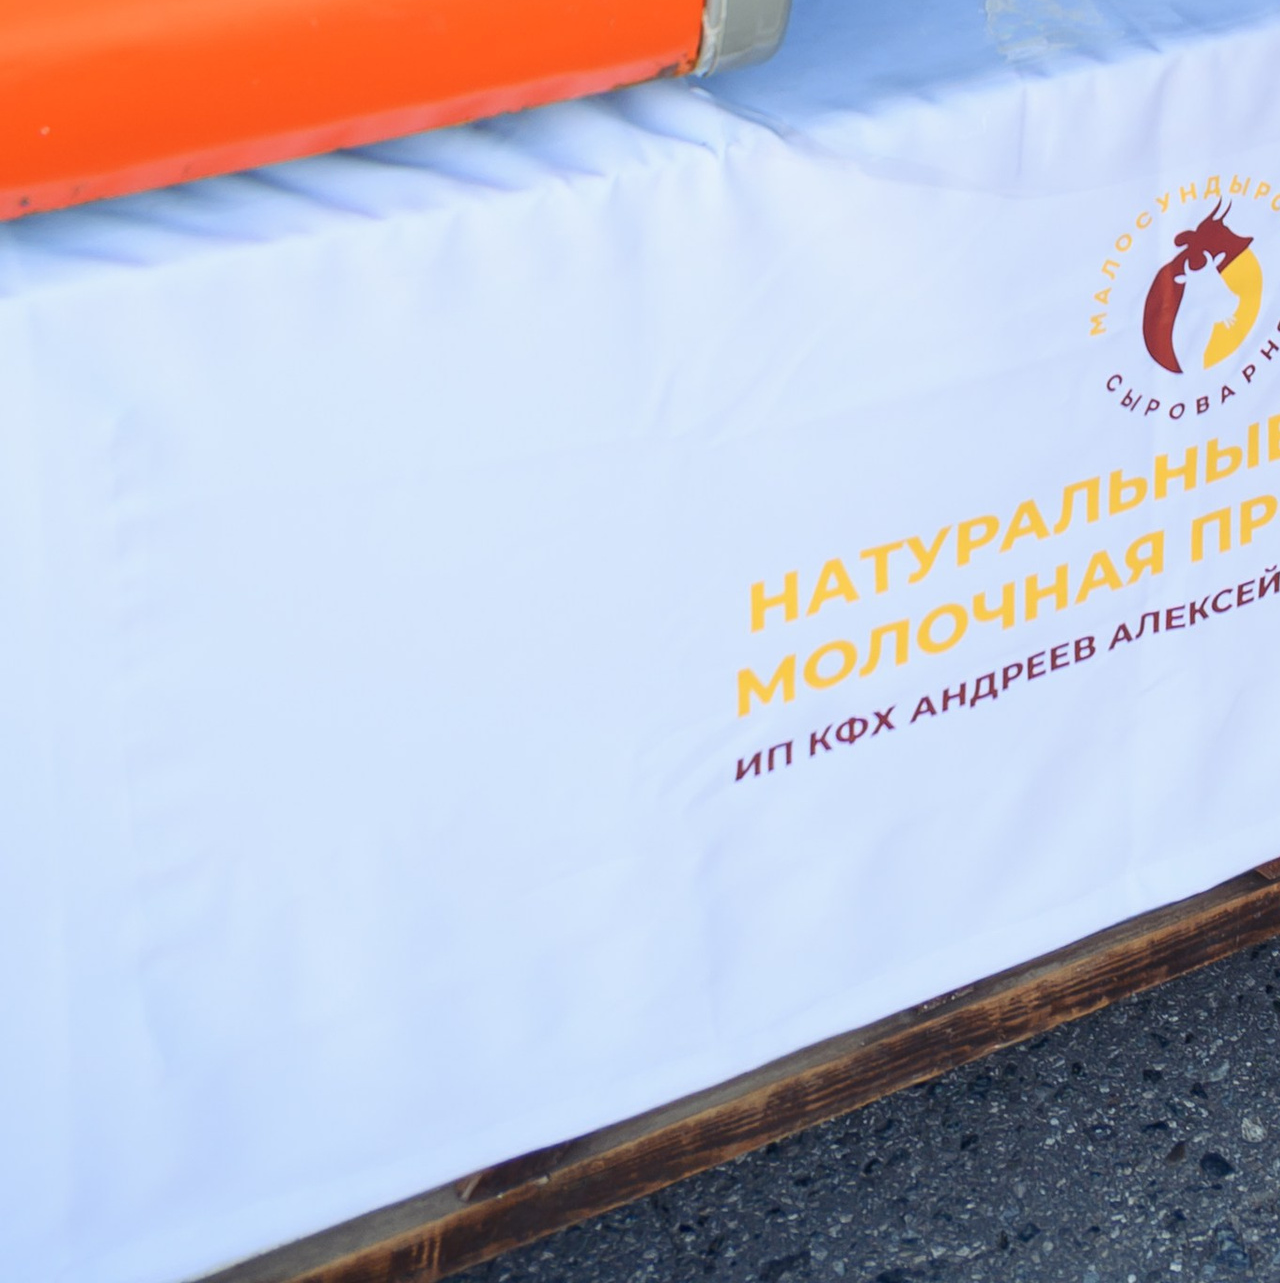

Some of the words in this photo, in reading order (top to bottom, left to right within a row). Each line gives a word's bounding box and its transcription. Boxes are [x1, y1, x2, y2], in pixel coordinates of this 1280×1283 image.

[735, 740, 793, 782] ИП
[809, 705, 896, 757] КФХ
[909, 635, 1096, 724] АНДРЕЕВ
[1108, 565, 1280, 652] АЛЕКСЕЙ
[737, 530, 1165, 718] МОЛОЧНАЯ
